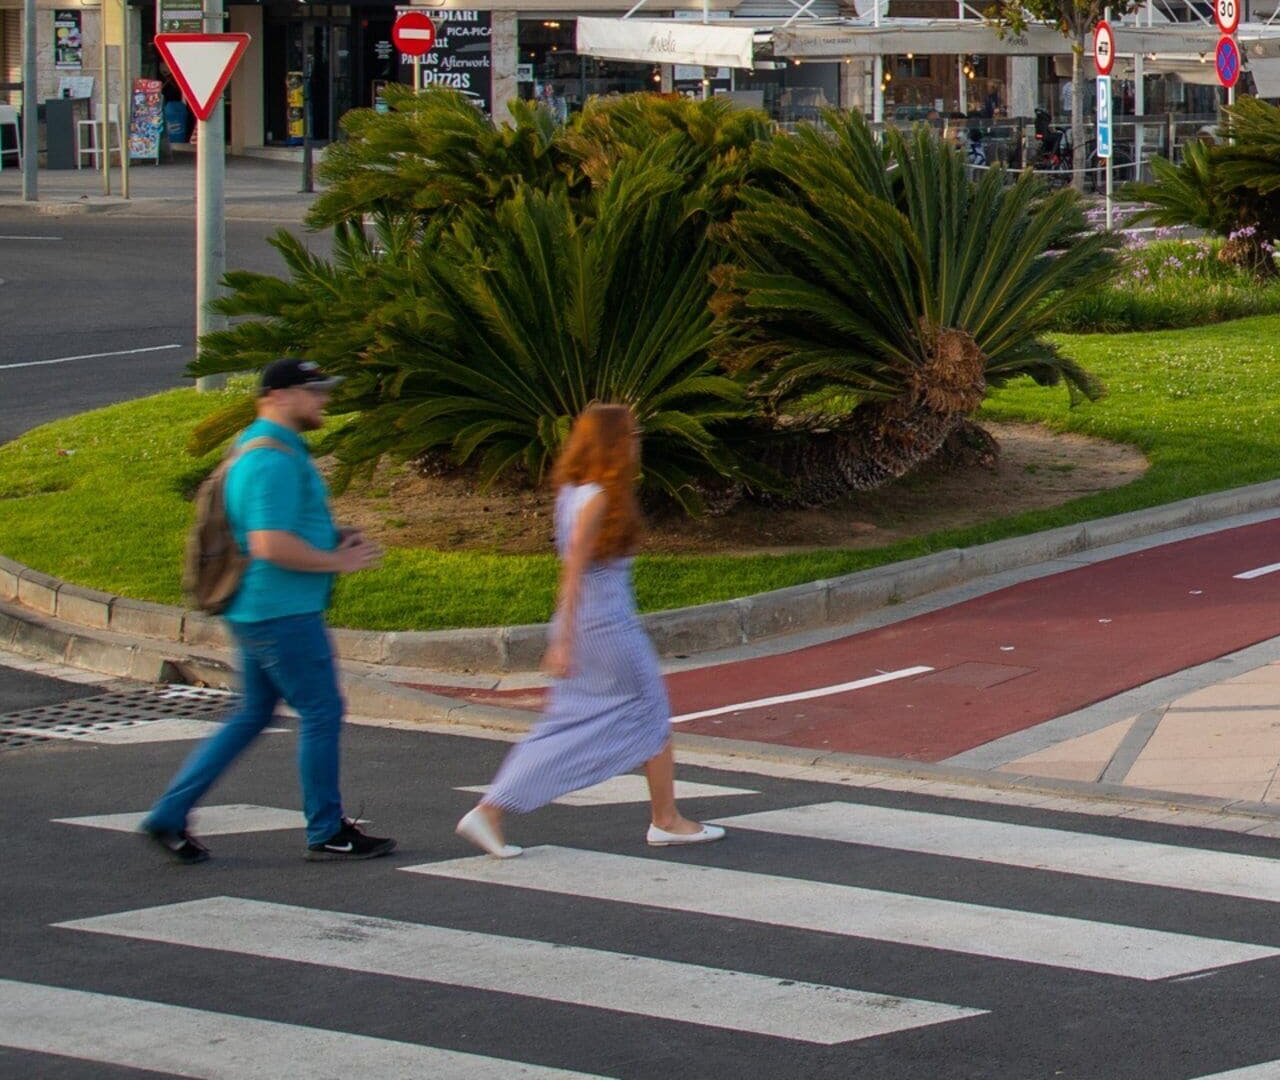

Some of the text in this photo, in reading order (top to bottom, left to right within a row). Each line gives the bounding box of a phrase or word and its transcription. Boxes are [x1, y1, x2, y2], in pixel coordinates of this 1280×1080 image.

[440, 11, 478, 21] DIARI
[1219, 1, 1234, 18] 30
[440, 55, 490, 71] Afterwork
[423, 69, 471, 88] Pizzas
